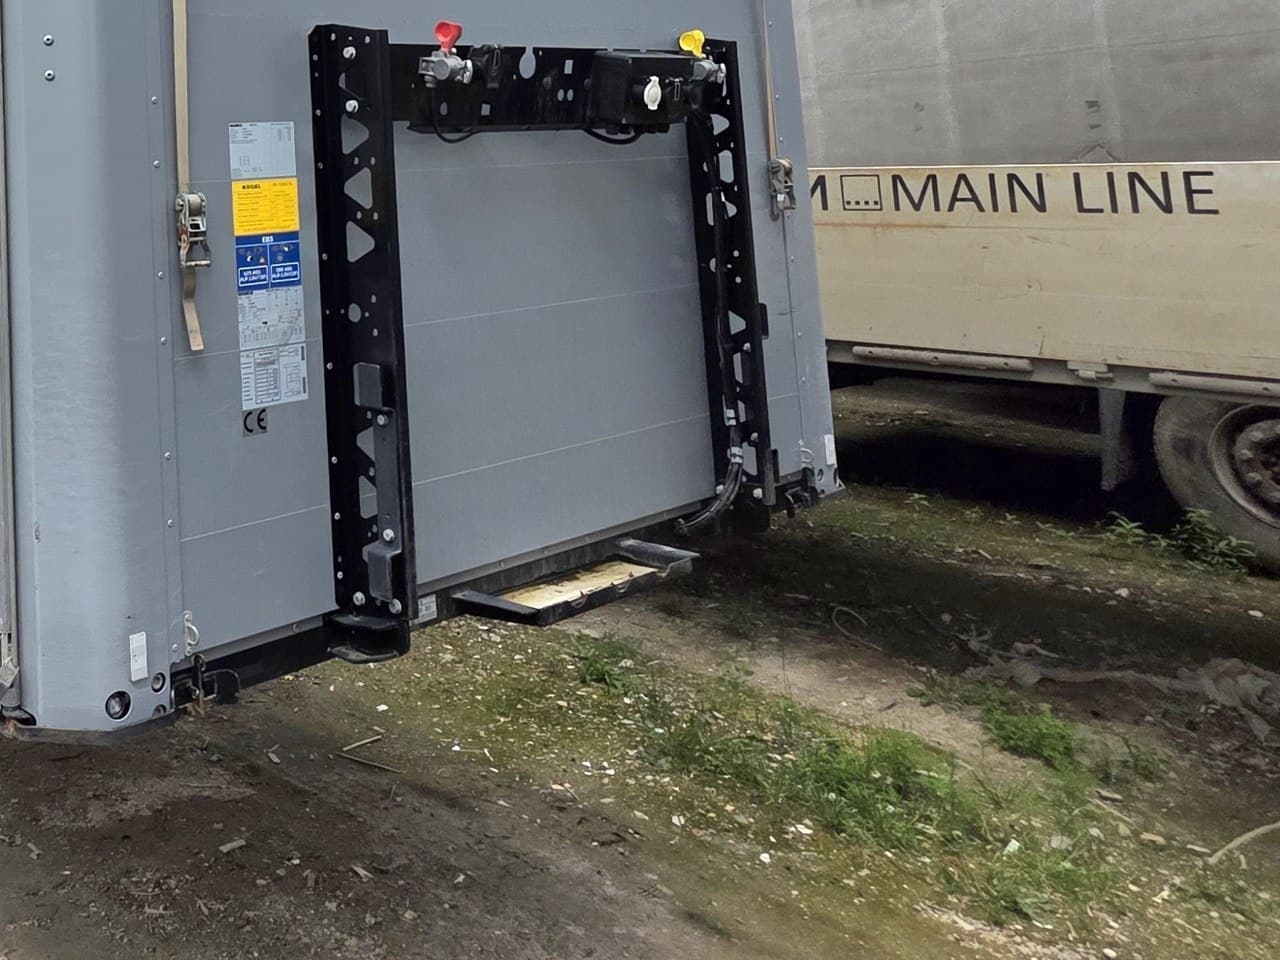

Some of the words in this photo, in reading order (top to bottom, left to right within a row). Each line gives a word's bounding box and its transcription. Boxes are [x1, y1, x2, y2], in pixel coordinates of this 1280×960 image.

[891, 172, 1047, 214] MAIN
[1073, 171, 1220, 215] LINE
[243, 408, 267, 433] CE
